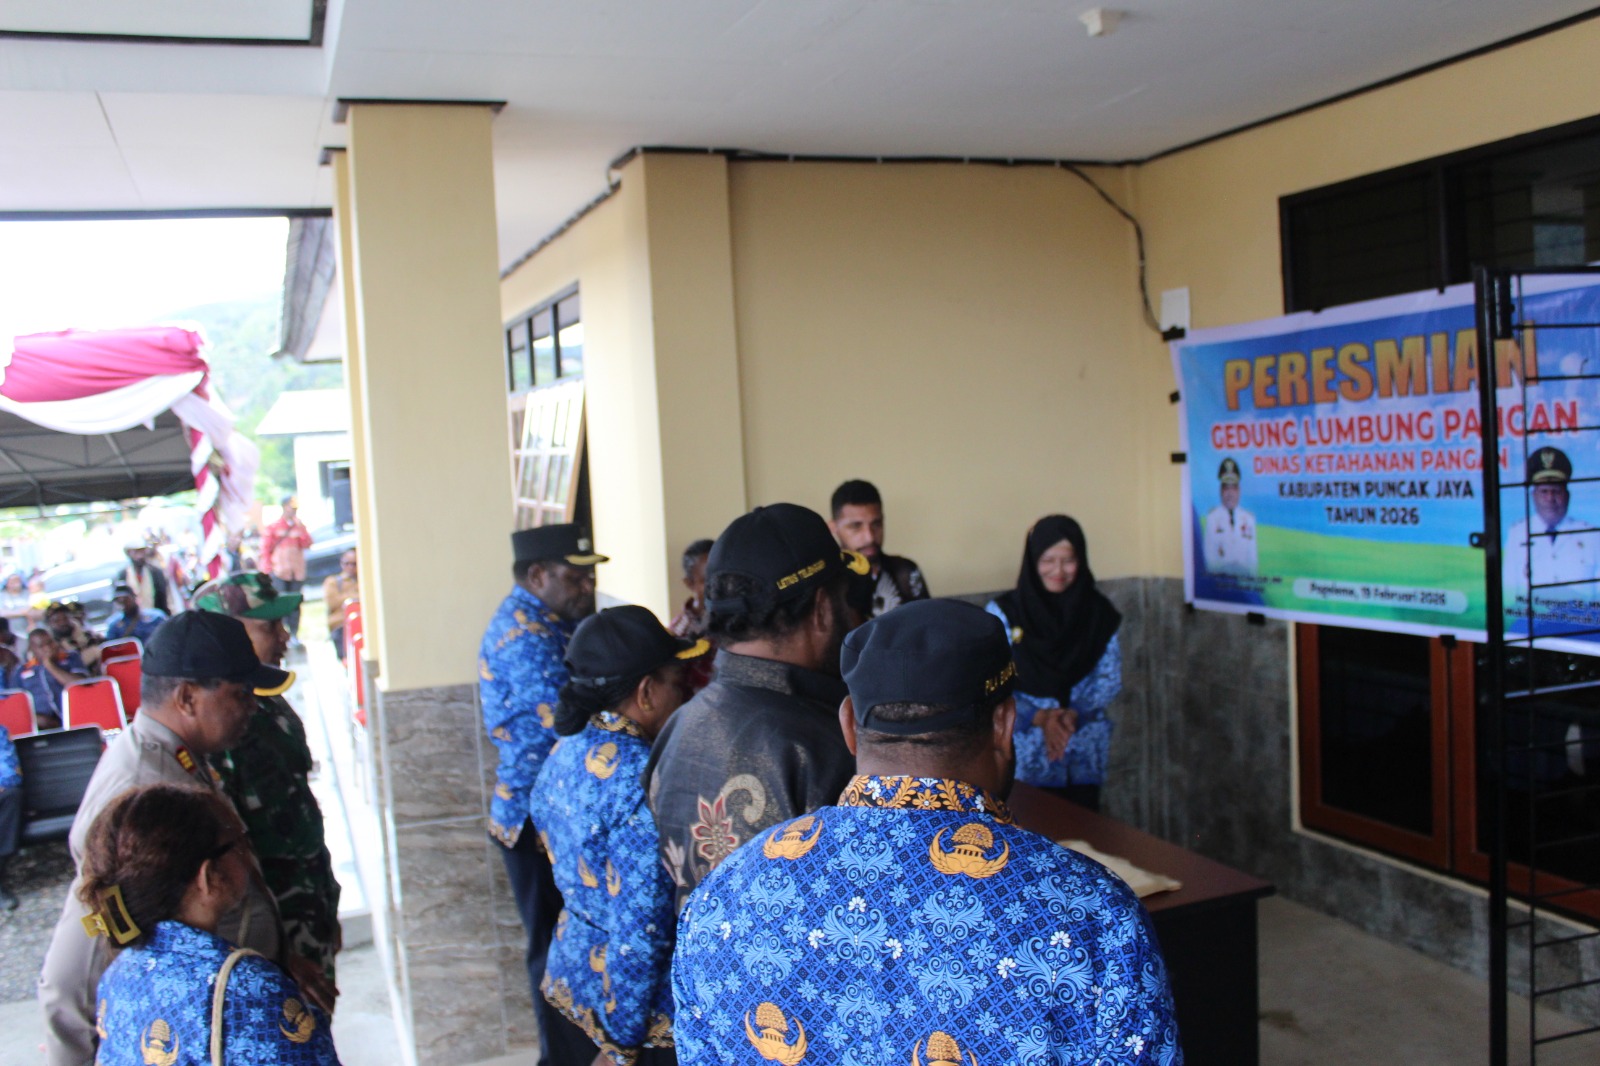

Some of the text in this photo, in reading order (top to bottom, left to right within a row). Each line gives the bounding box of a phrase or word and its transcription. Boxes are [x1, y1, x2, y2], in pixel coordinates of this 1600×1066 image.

[1224, 321, 1538, 412] PERESMIAN
[1211, 420, 1298, 449] GEDUNG
[1304, 412, 1434, 446] LUMBUNG
[1253, 454, 1300, 474] DINAS
[1305, 451, 1415, 474] KETAHANAN
[1278, 480, 1474, 499] KABUPATEN PUNCAK JAYA
[1326, 507, 1420, 525] TAHUN 2026
[1374, 587, 1417, 603] Februari
[1420, 590, 1447, 606] 2026
